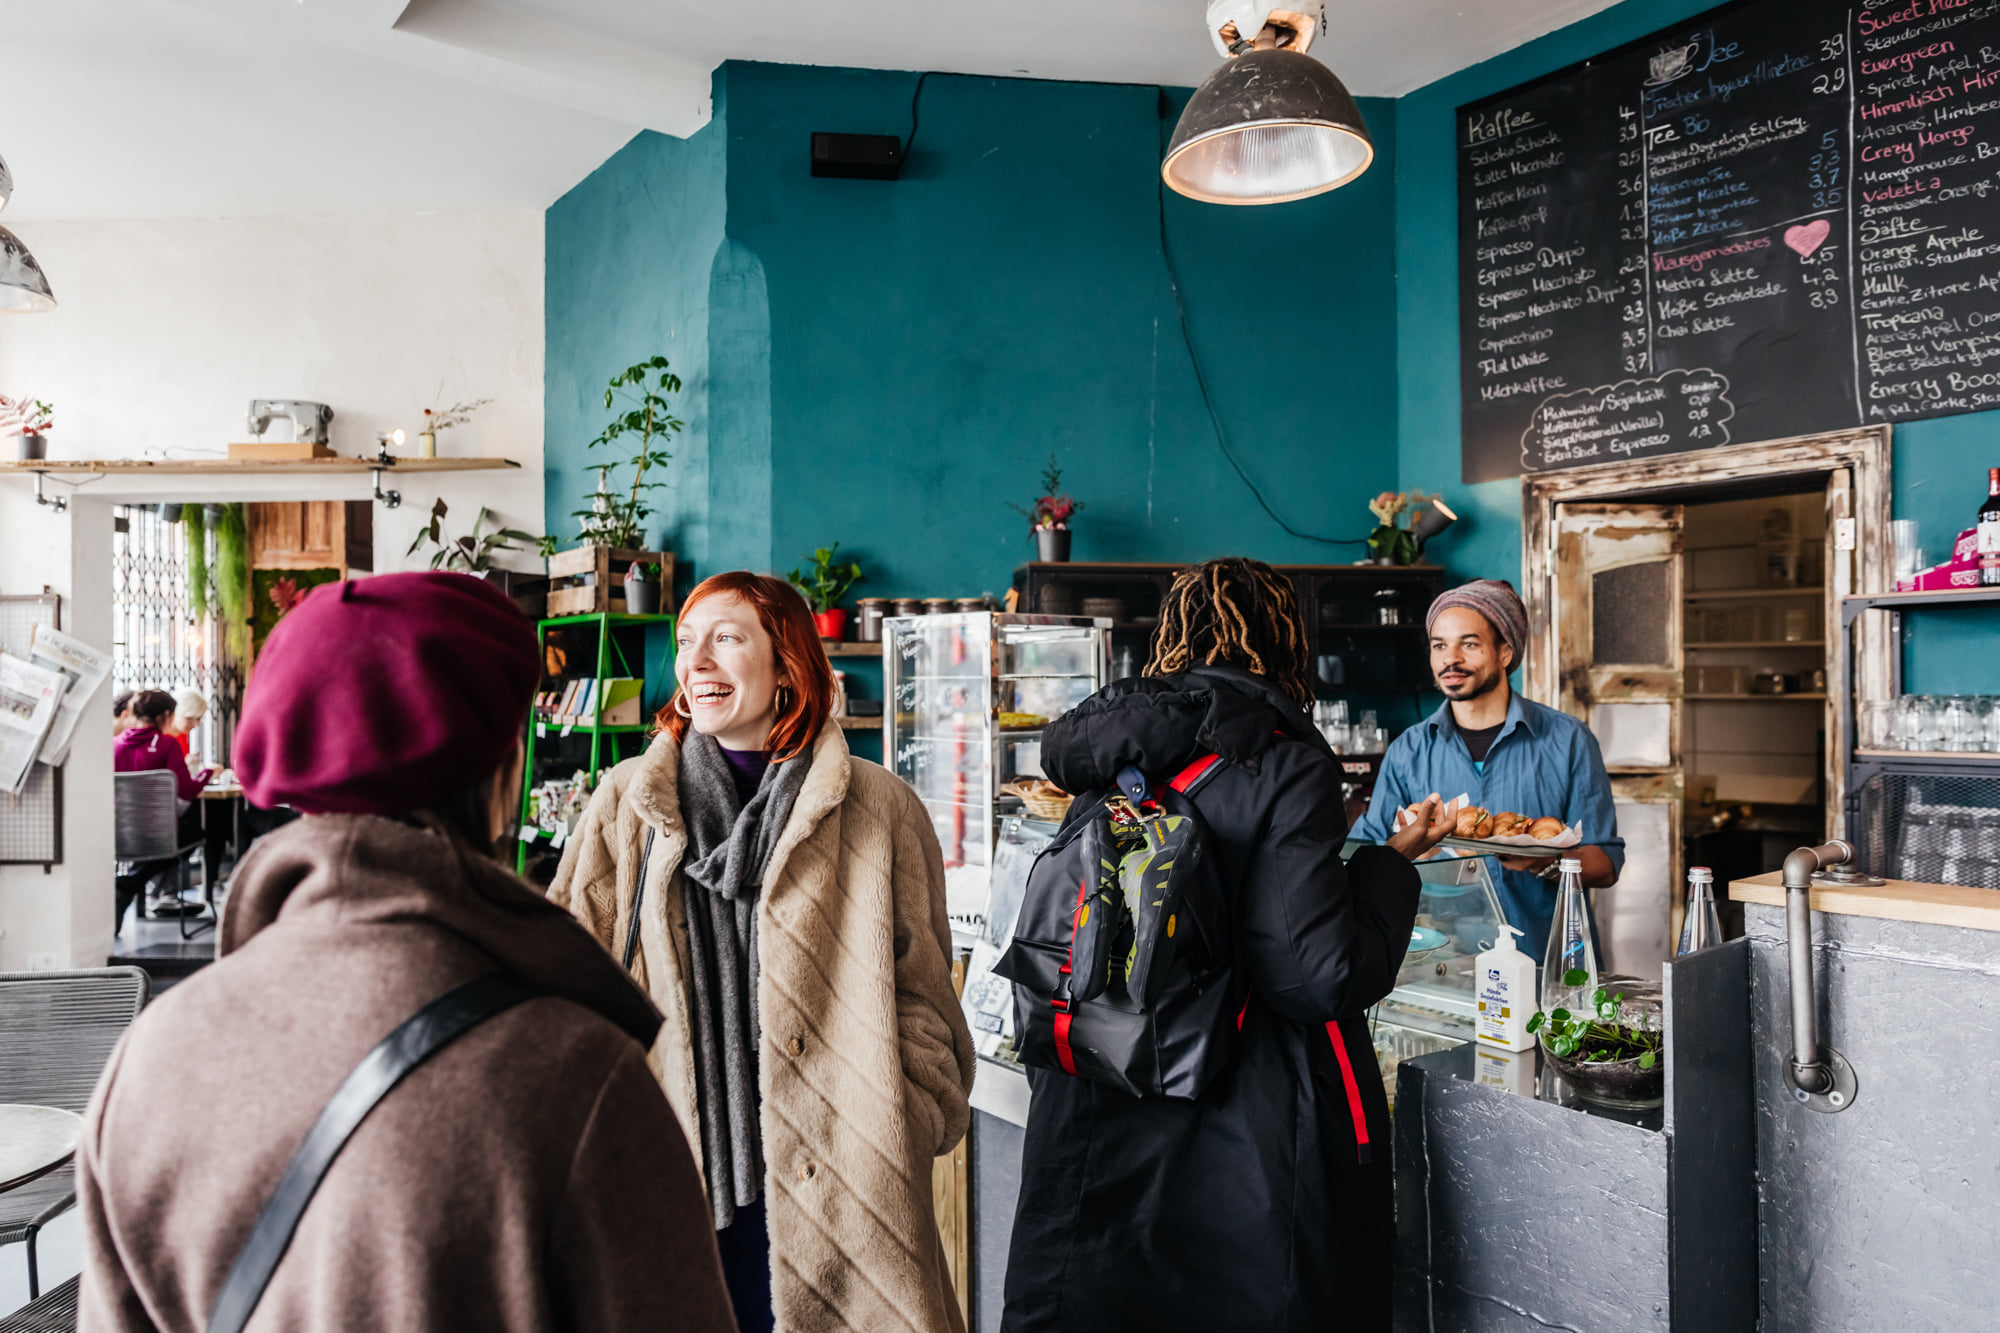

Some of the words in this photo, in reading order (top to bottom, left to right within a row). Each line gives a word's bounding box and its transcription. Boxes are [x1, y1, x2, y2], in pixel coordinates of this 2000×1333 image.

[1858, 0, 1924, 35] Sweet
[1861, 41, 1955, 74] Evergreen
[1861, 85, 1954, 120] Himmlisch
[1934, 101, 2000, 125] Himbee
[1468, 108, 1535, 143] Kaffee
[1643, 123, 1681, 151] Tee
[1918, 125, 1975, 147] Mango
[1976, 142, 2000, 159] Ba
[1863, 177, 1941, 203] Violetta
[1859, 216, 1929, 241] Säfte
[1477, 240, 1534, 264] Espresso
[1653, 236, 1772, 273] Hausgemachtes
[1860, 243, 1919, 262] Orange
[1926, 226, 1985, 251] Apple
[1926, 243, 2000, 267] Staudens
[1478, 262, 1537, 286] Espresso
[1862, 274, 1909, 297] Hulk
[1978, 272, 2000, 293] Ap
[1478, 289, 1529, 310] Espresso
[1478, 311, 1526, 330] Espresso
[1860, 305, 1945, 332] Tropicana
[1967, 311, 2000, 328] Ora
[1866, 343, 1930, 363] Bloody
[1868, 378, 1942, 400] Energy
